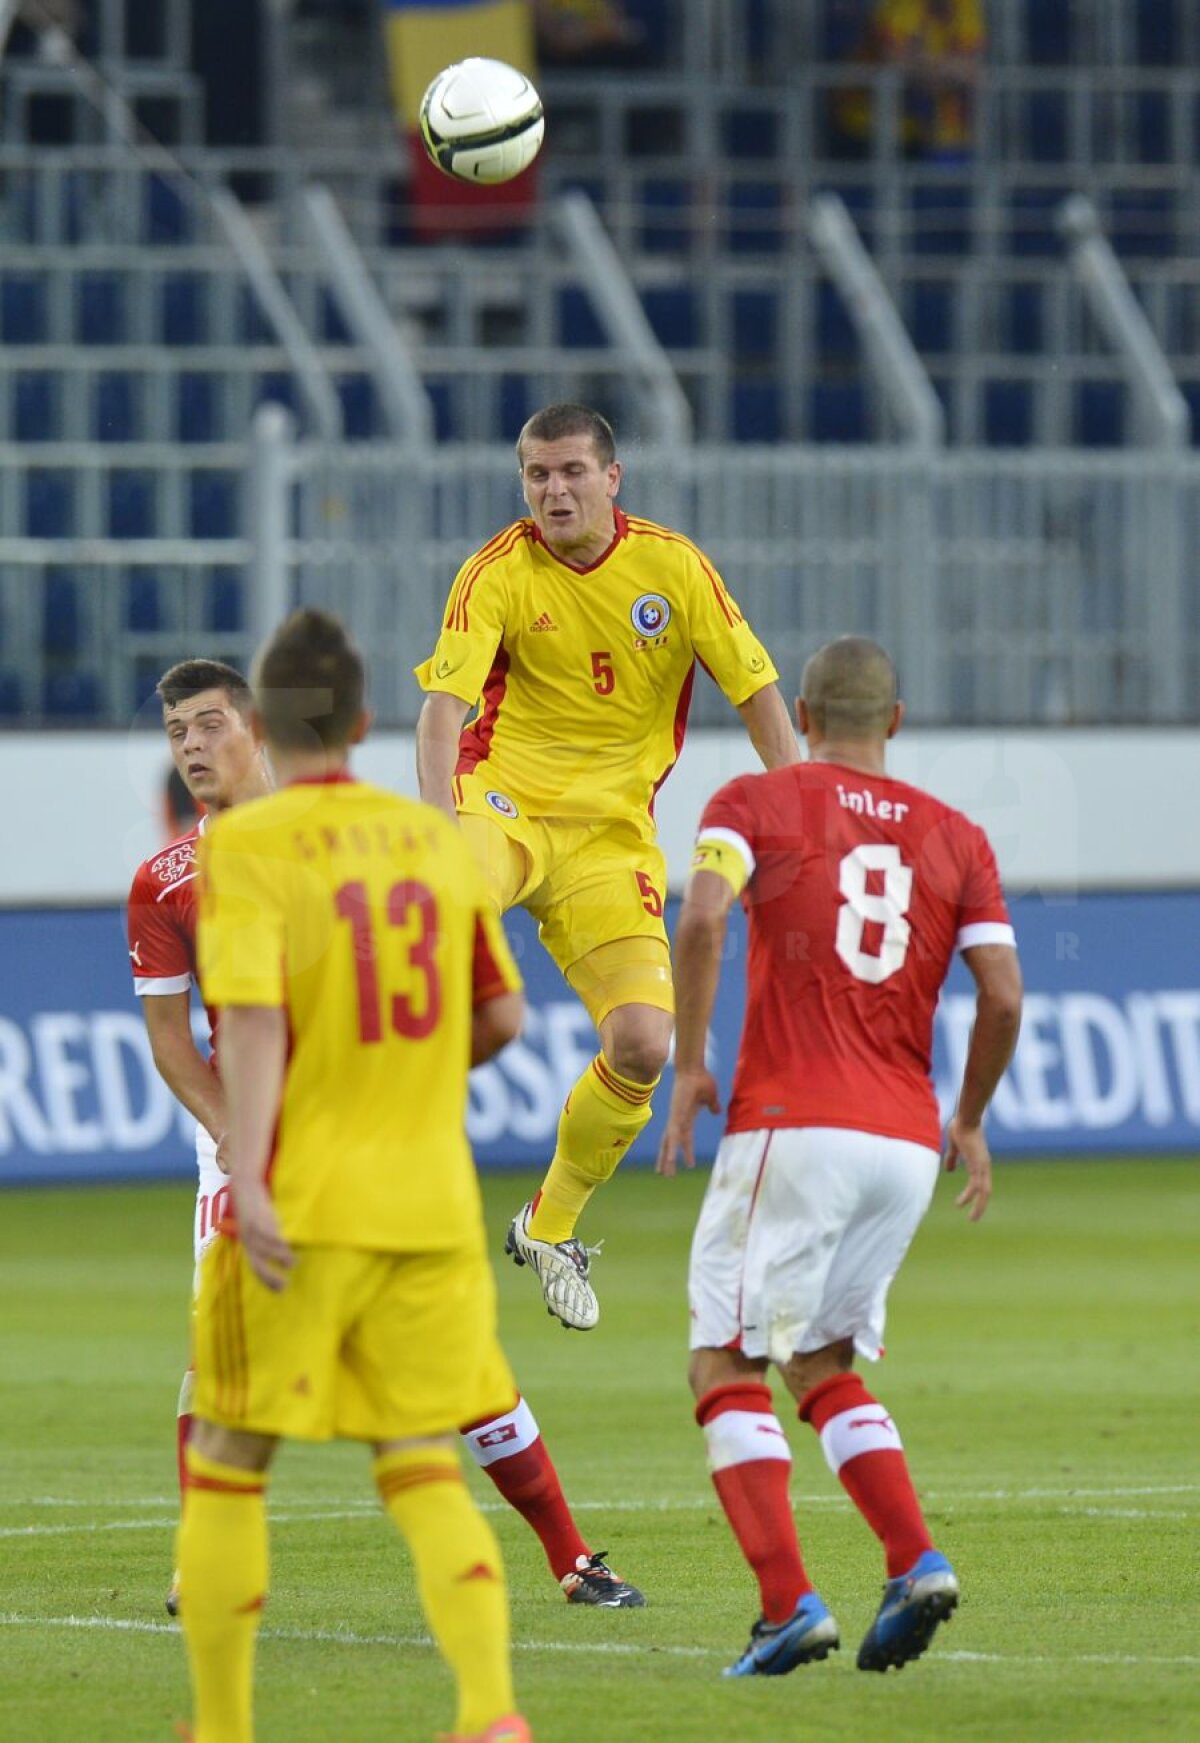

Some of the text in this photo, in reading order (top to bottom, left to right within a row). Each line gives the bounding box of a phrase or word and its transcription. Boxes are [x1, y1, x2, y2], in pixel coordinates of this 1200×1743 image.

[529, 624, 559, 633] adidas
[591, 651, 616, 696] 5
[836, 784, 910, 824] inler
[634, 870, 662, 917] 5
[836, 844, 912, 983] 8
[334, 879, 442, 1044] 13
